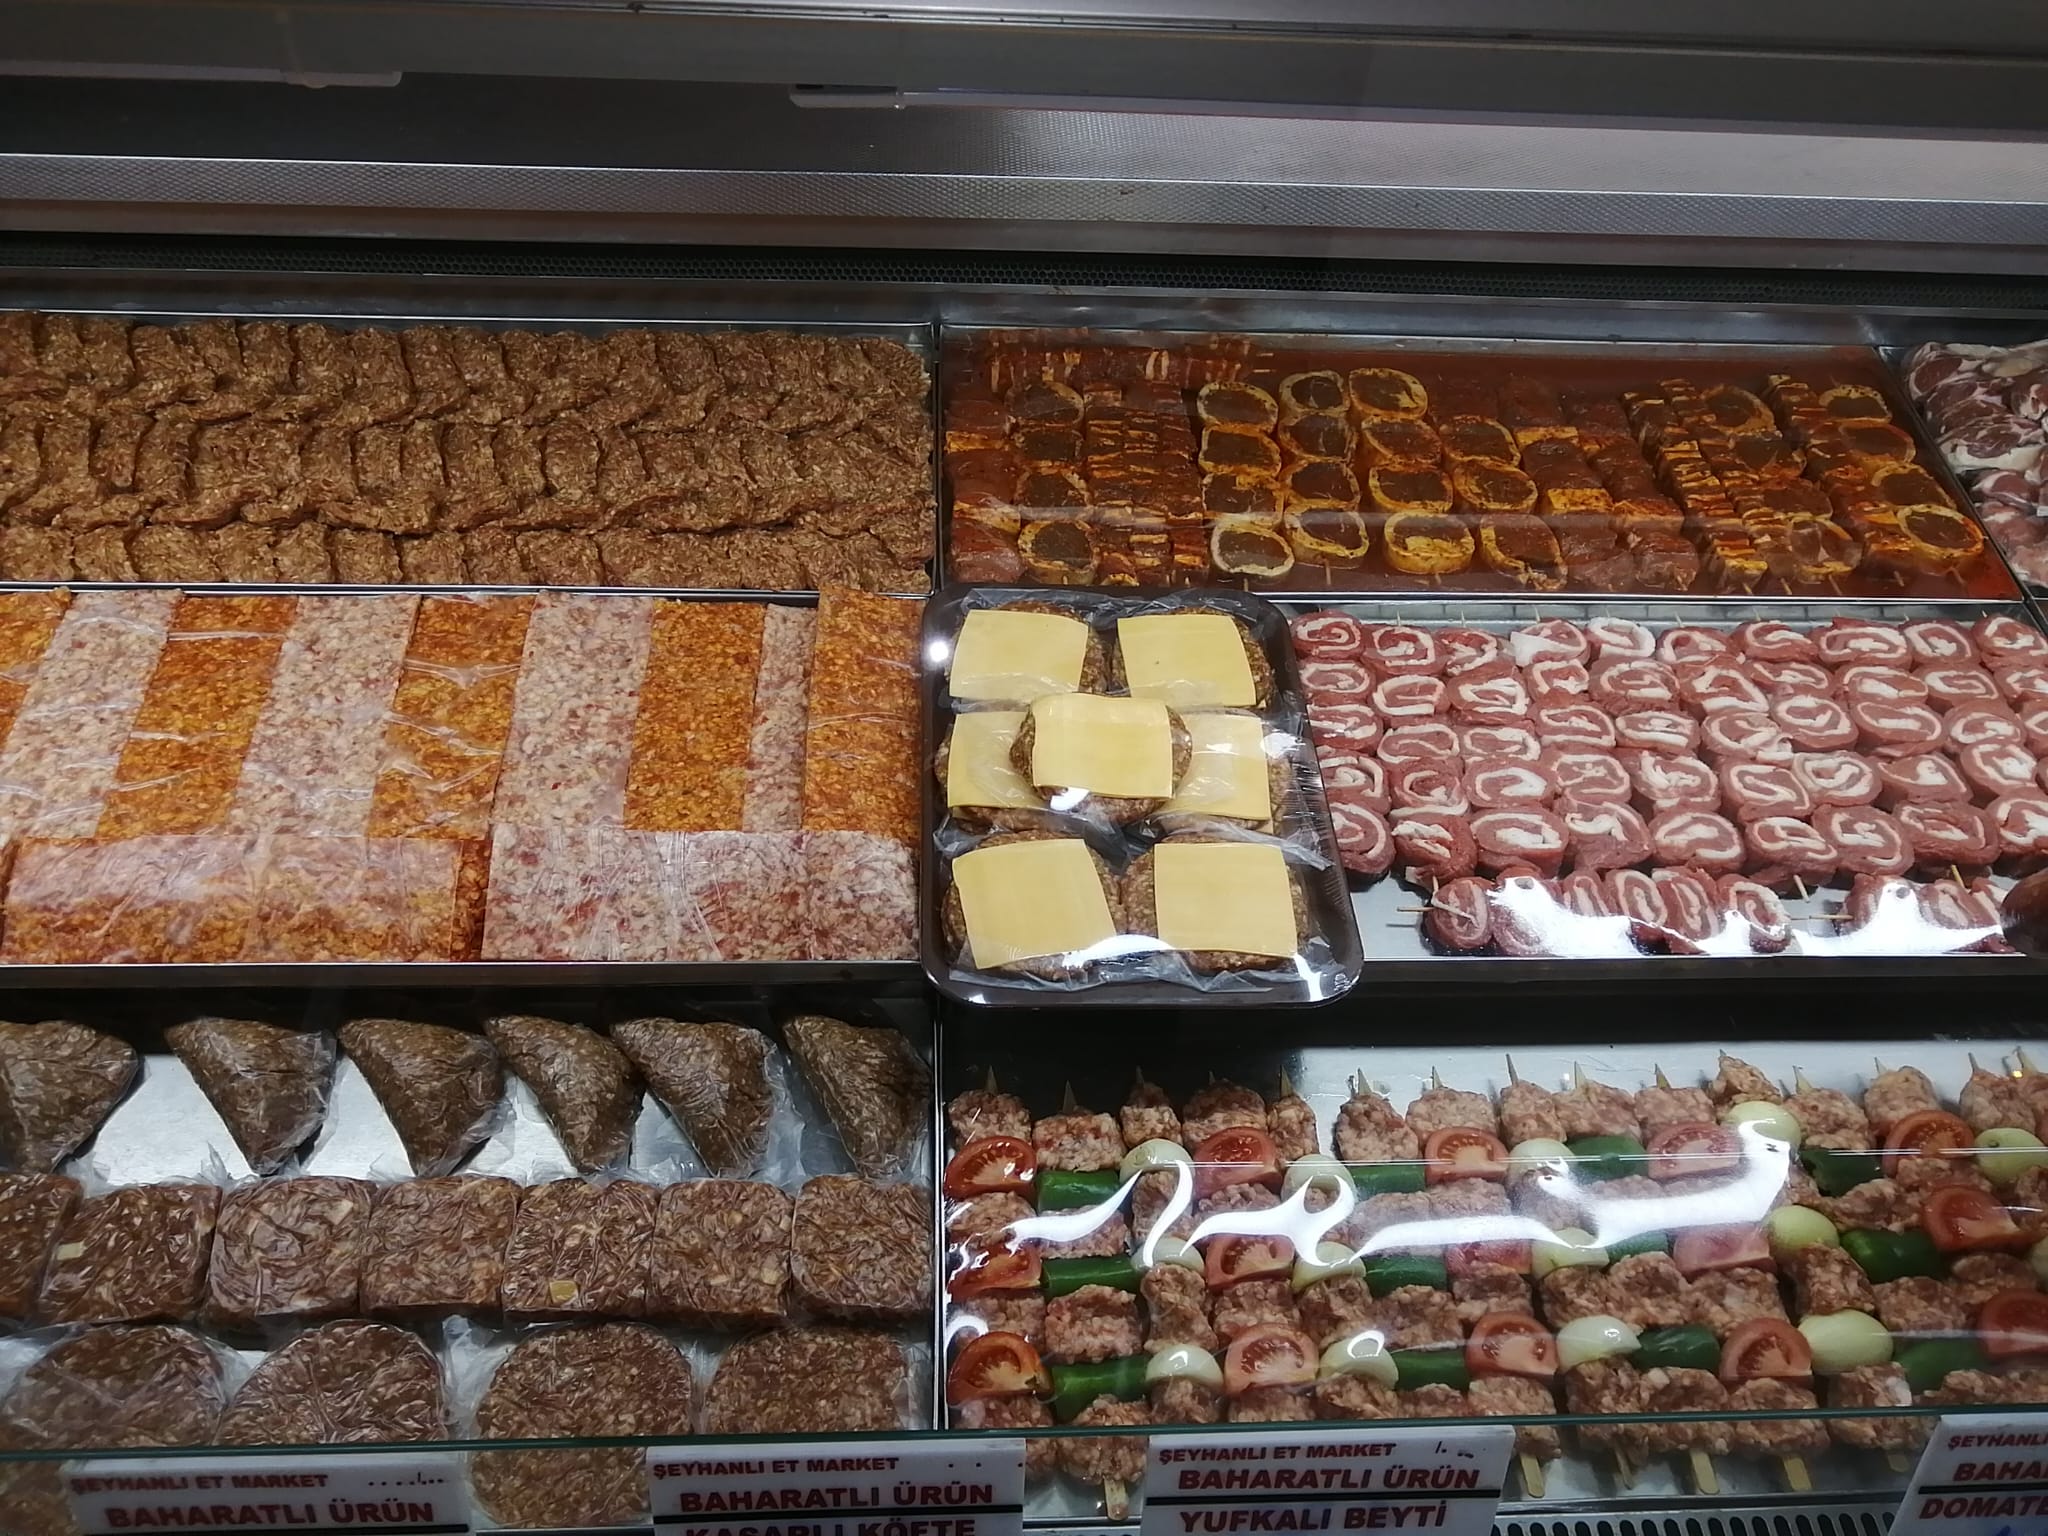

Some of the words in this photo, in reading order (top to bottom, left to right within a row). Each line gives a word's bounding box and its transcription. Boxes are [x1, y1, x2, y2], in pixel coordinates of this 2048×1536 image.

[1159, 1447, 1267, 1466] ŞEYHANLI
[1273, 1446, 1302, 1460] ET
[1306, 1443, 1397, 1459] MARKET
[196, 1475, 223, 1488] ET
[232, 1473, 328, 1488] MARKET
[653, 1460, 765, 1480] ŞEYHANLI
[772, 1460, 800, 1474] ET
[807, 1457, 900, 1473] MARKET
[1178, 1469, 1372, 1490] BAHARATLI
[1383, 1465, 1480, 1489] ÜRÜN
[680, 1487, 880, 1513] BAHARATLI
[893, 1480, 993, 1505] ÜRÜN
[105, 1503, 317, 1527] BAHARATLI
[329, 1498, 434, 1524] ÜRÜN
[1179, 1508, 1332, 1533] YUFKALI
[1343, 1500, 1447, 1530] BEYTİ
[857, 1517, 976, 1536] KÖFTE
